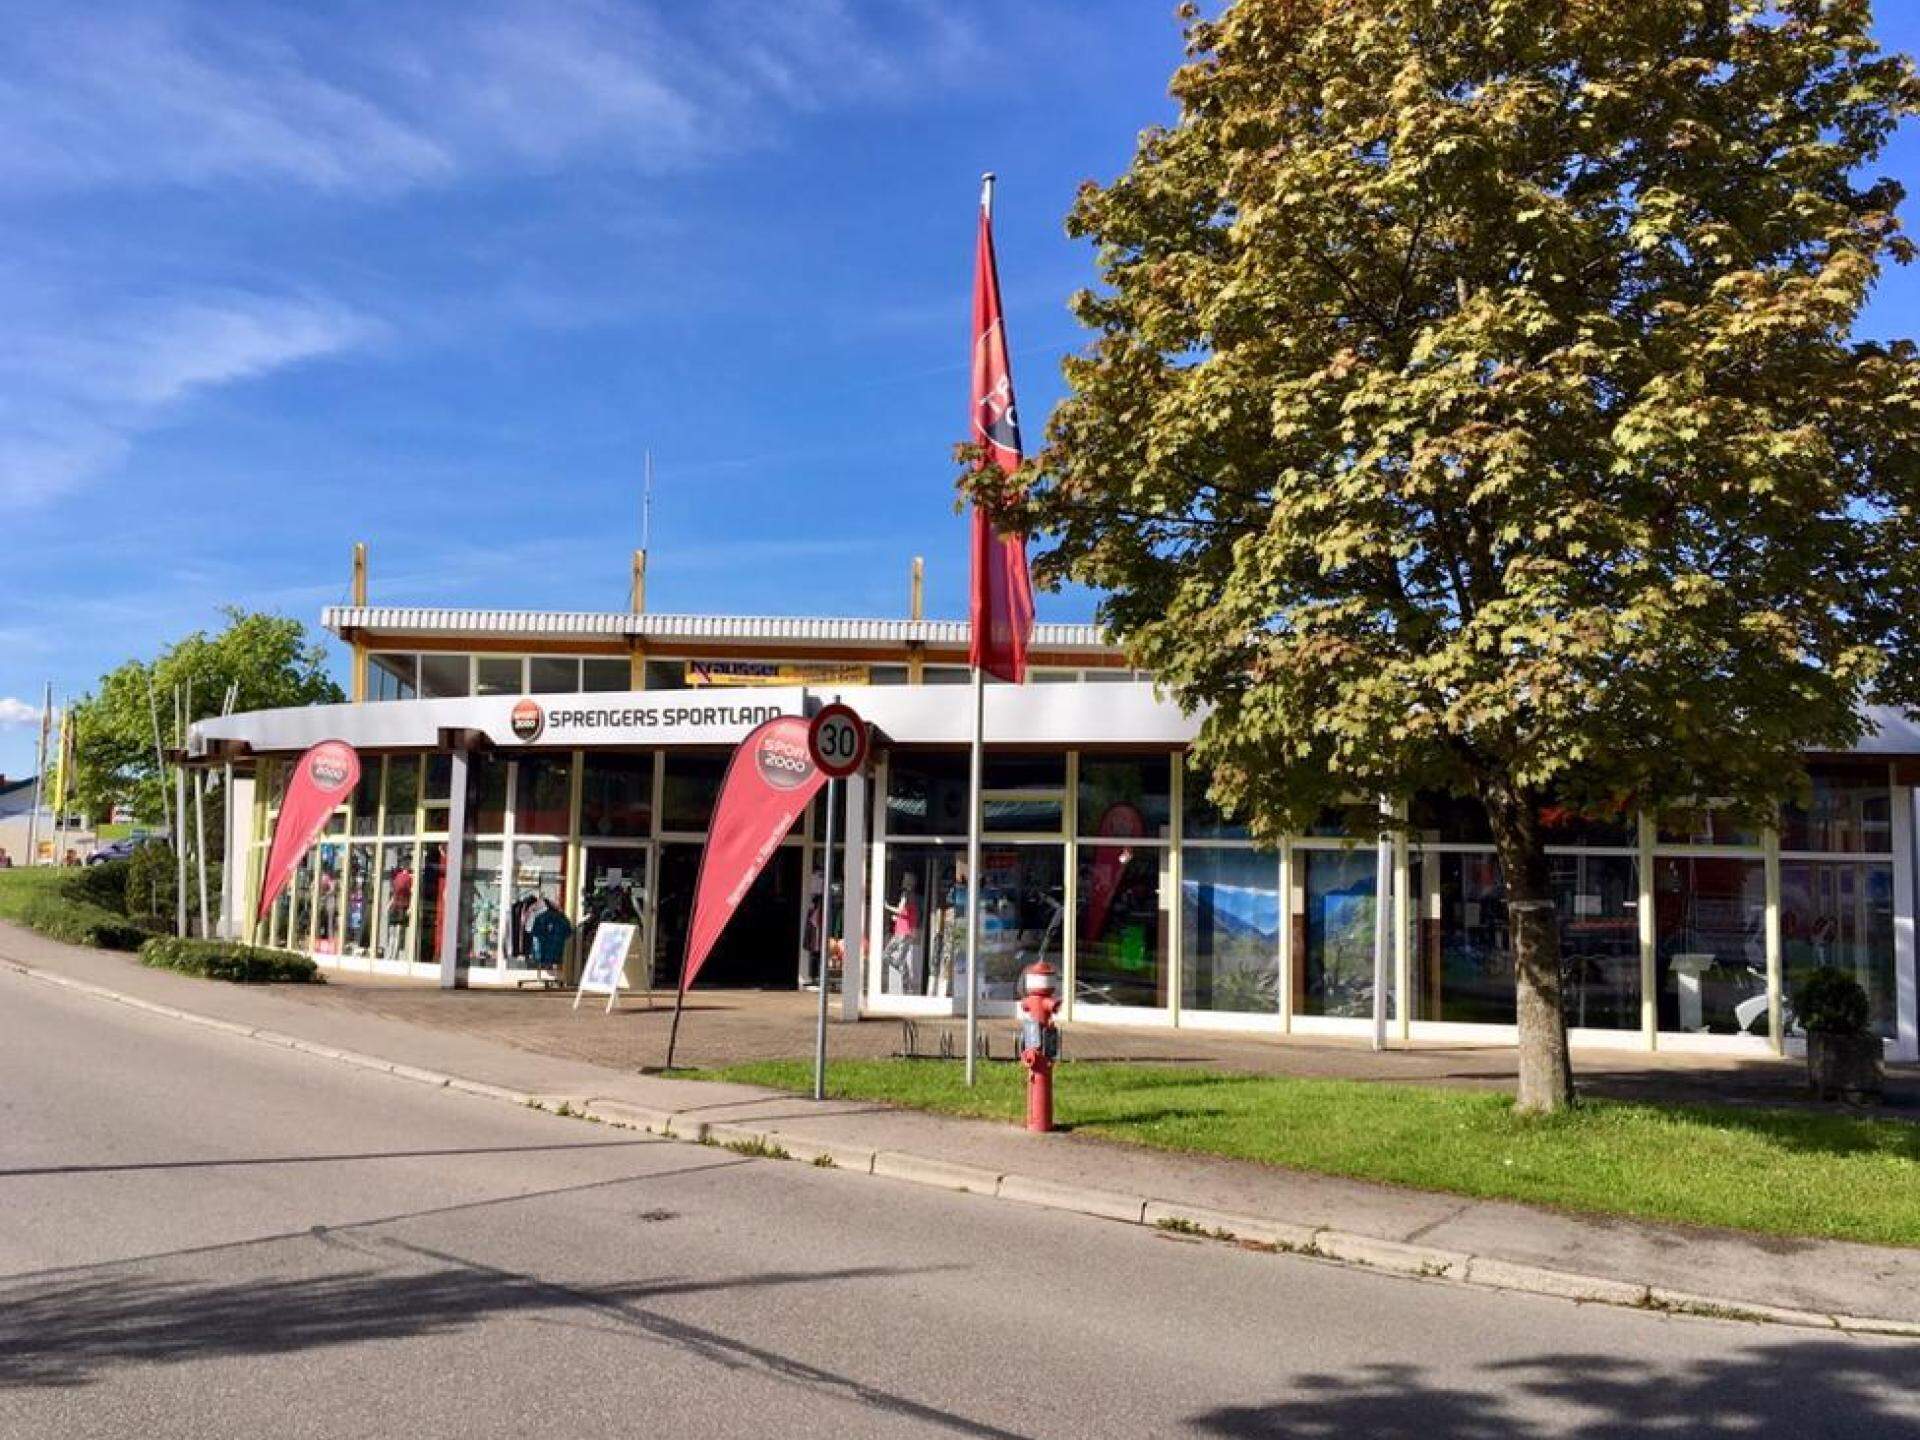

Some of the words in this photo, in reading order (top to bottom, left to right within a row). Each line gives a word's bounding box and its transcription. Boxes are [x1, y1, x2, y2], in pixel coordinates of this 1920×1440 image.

[549, 708, 658, 728] SPRENGERS
[663, 706, 782, 726] SPORTLAND
[821, 723, 855, 757] 30
[765, 752, 806, 773] 2000
